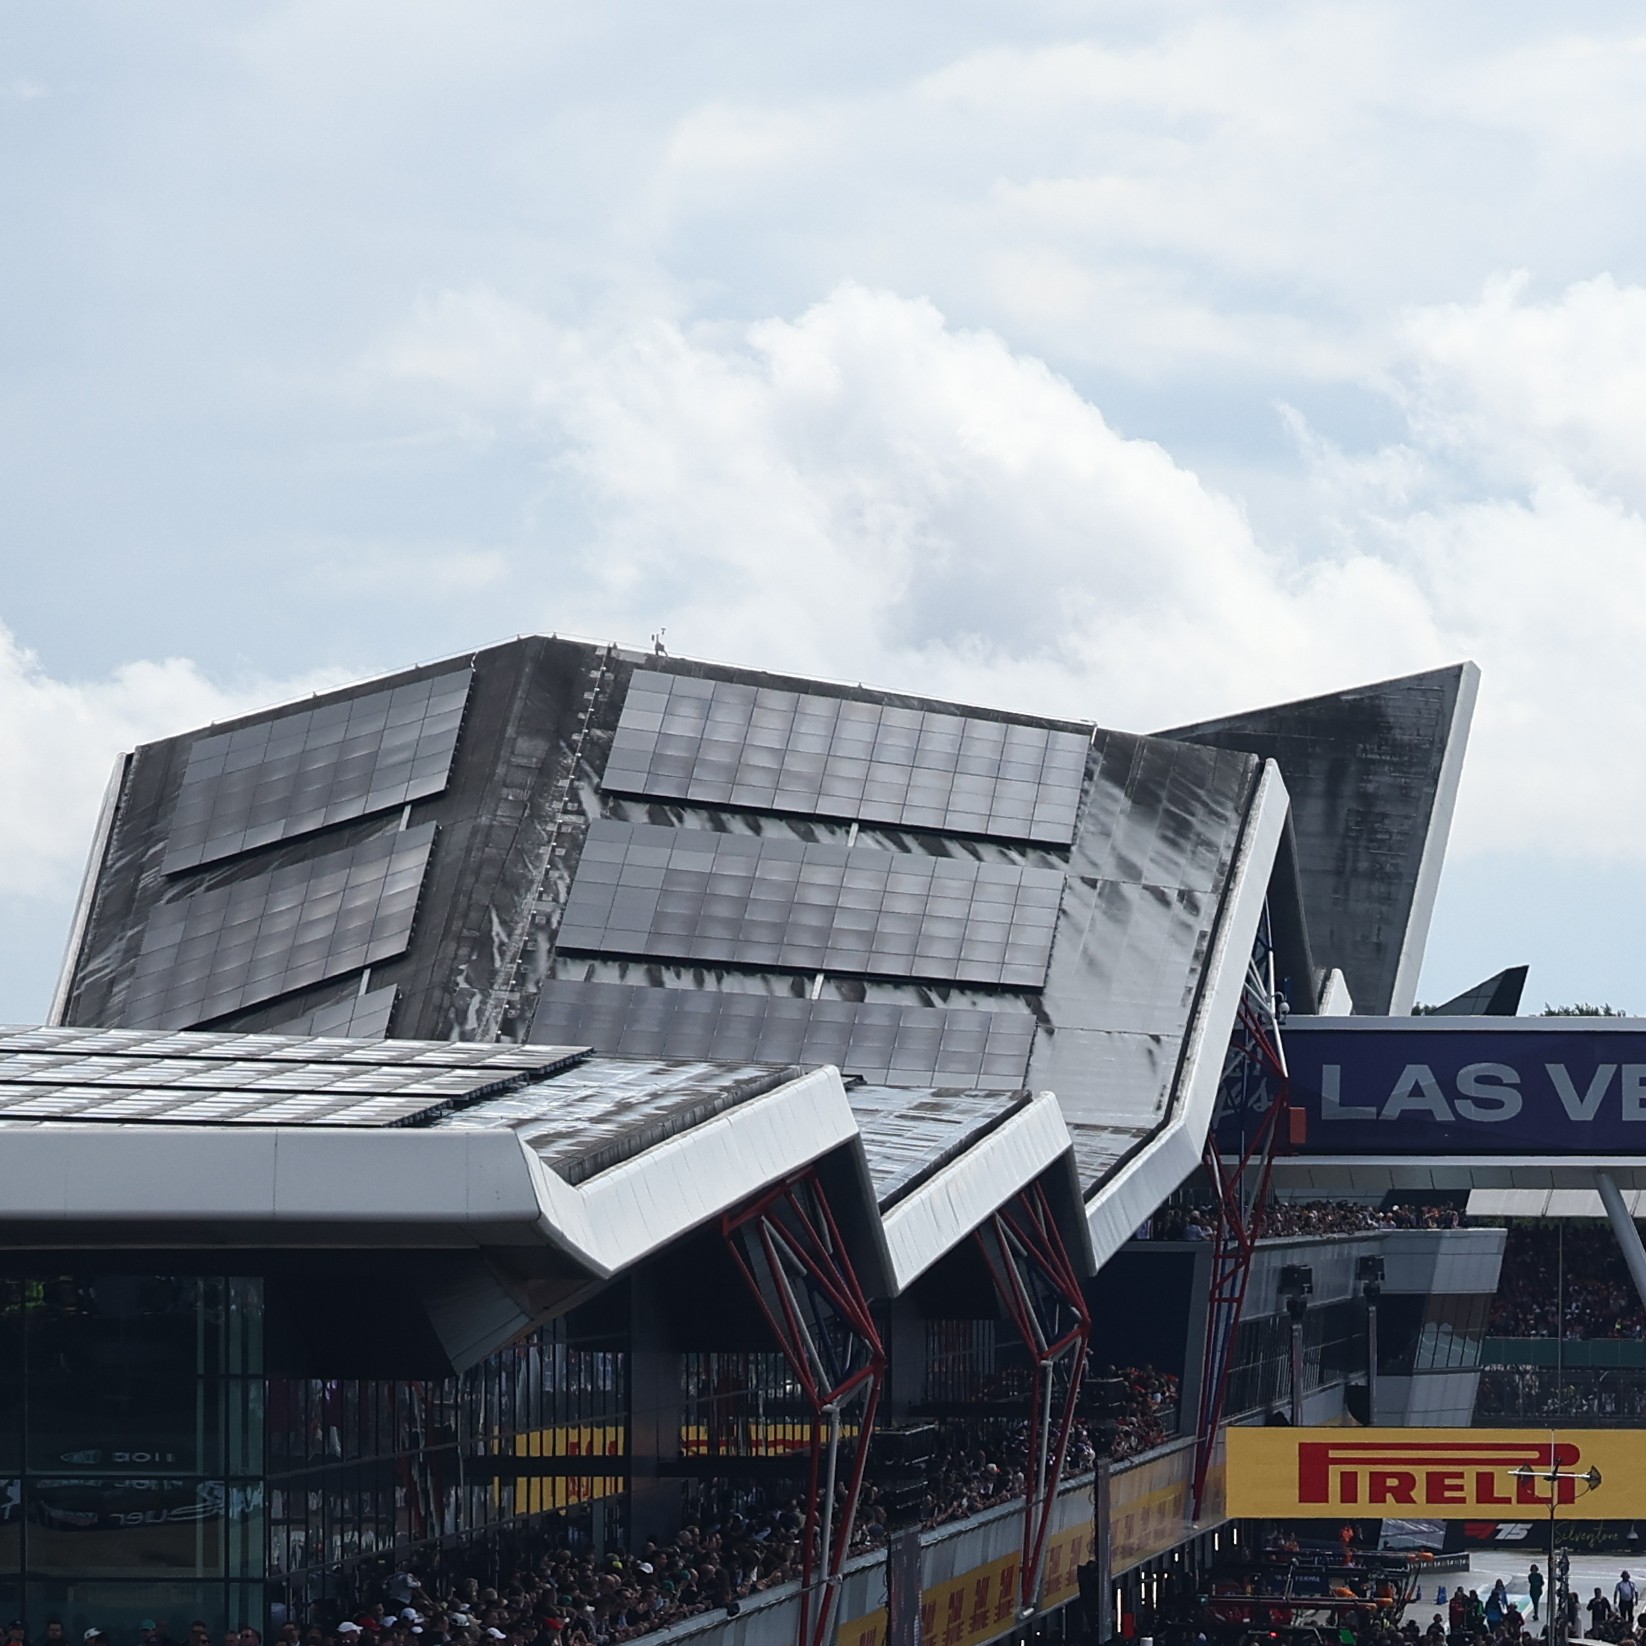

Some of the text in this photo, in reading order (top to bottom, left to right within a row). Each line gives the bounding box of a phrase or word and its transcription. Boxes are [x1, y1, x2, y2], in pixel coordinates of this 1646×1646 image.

[1320, 1063, 1523, 1123] LAS
[1298, 1442, 1581, 1505] PIRELLI
[1494, 1523, 1533, 1540] 75
